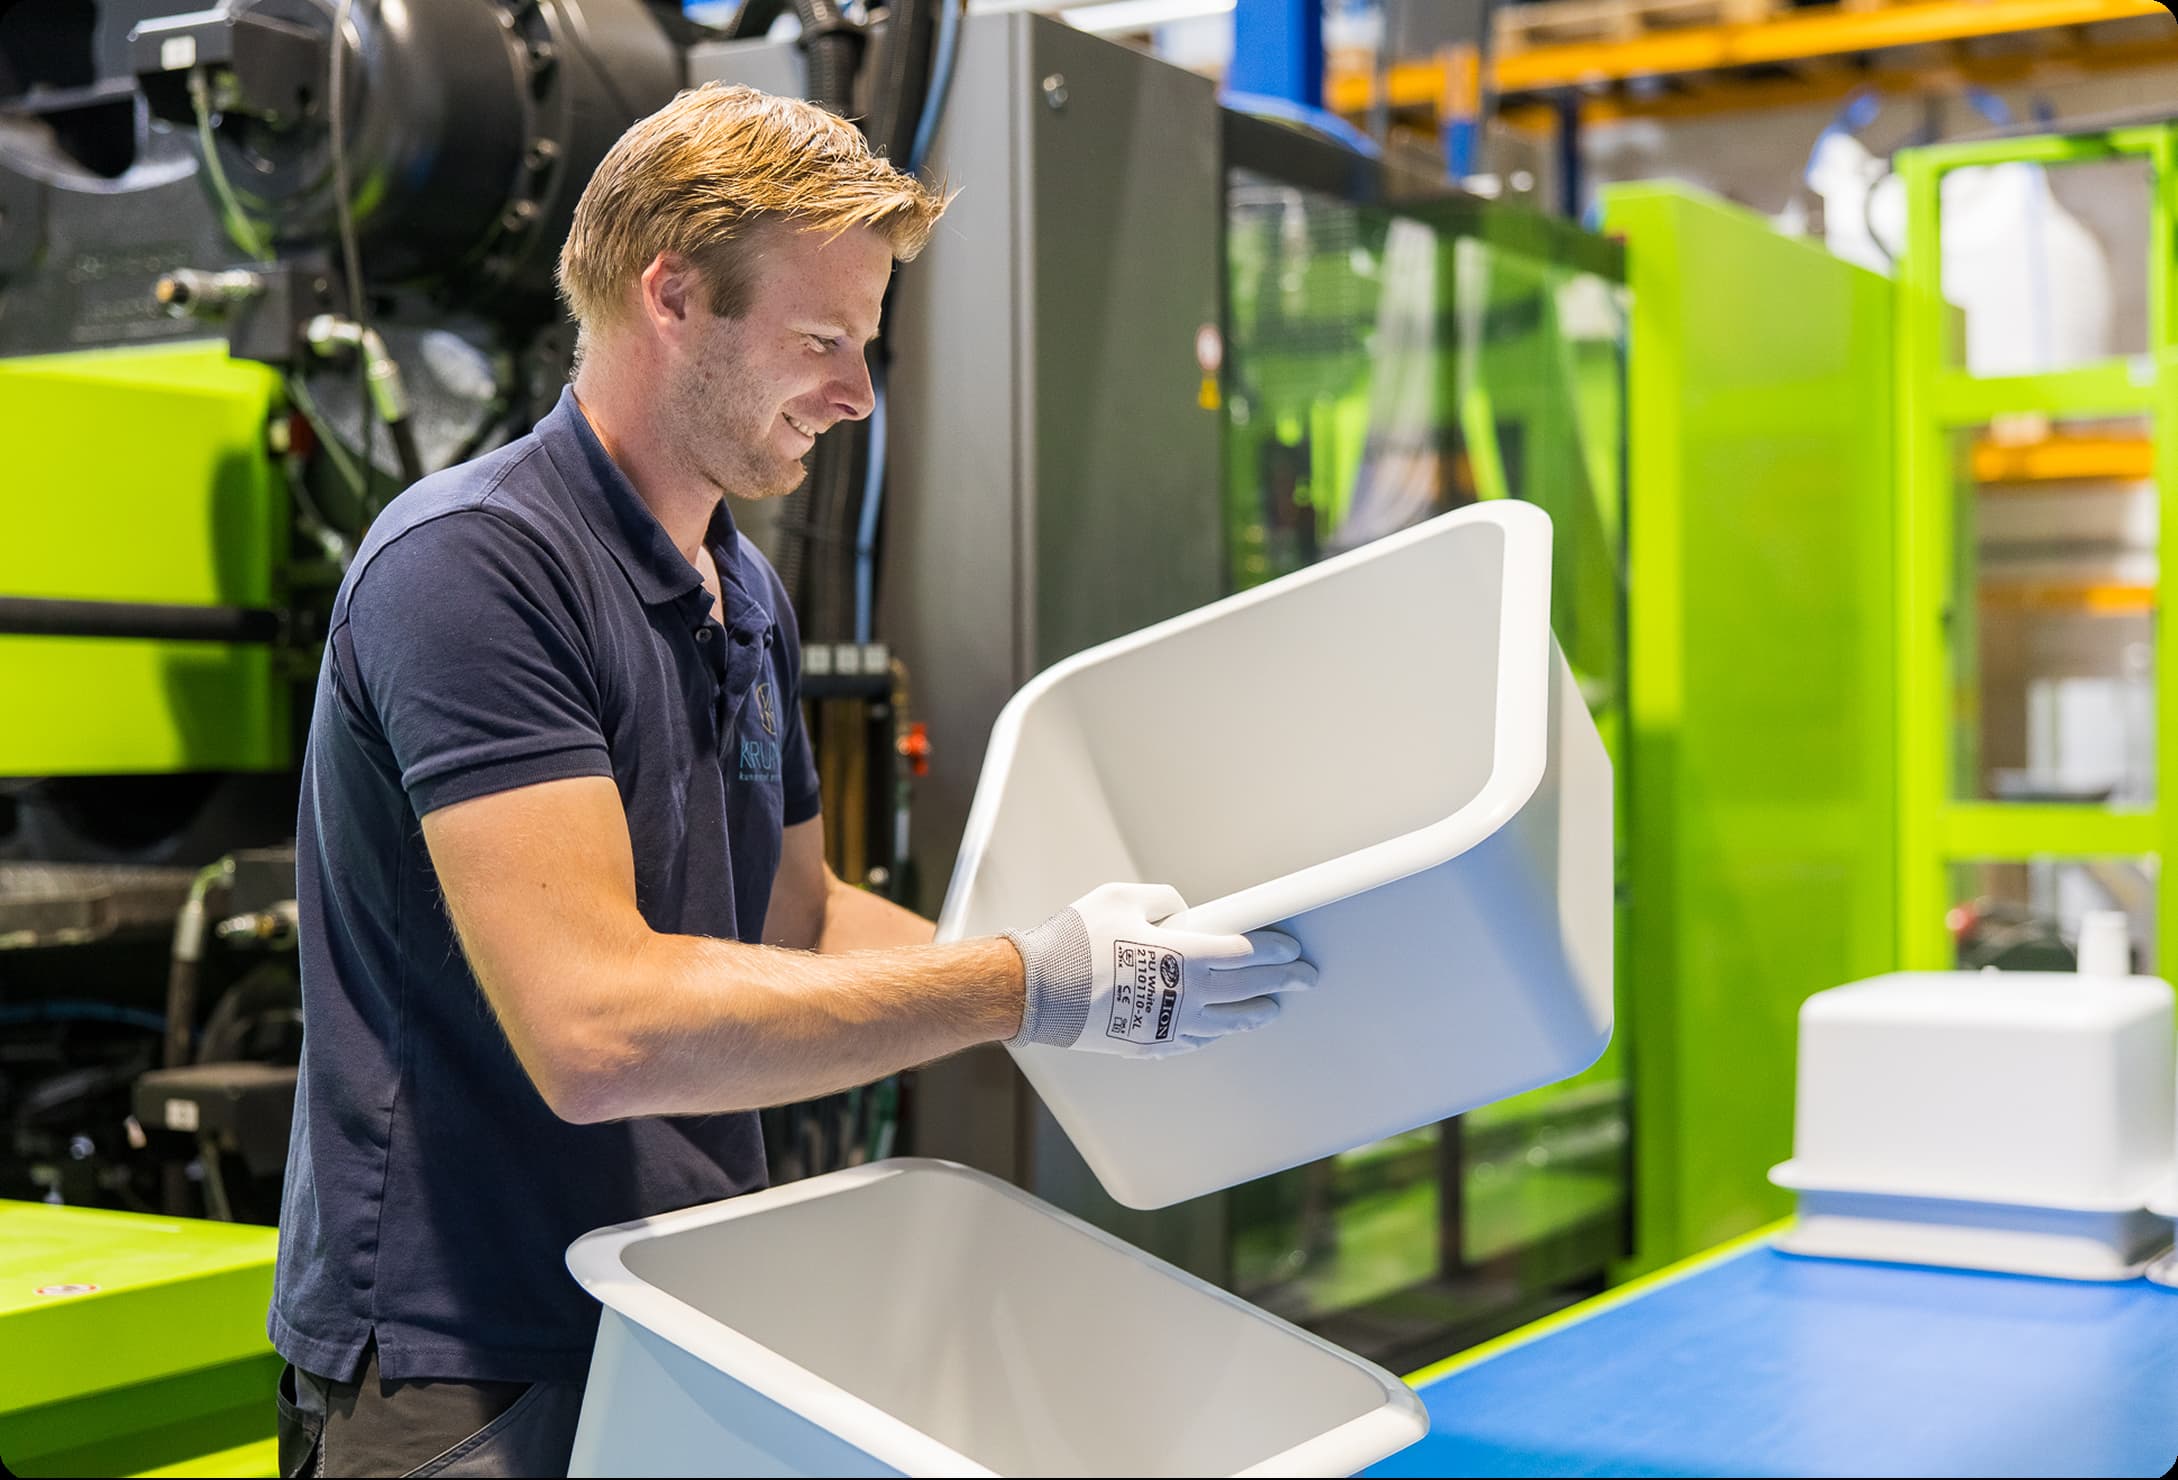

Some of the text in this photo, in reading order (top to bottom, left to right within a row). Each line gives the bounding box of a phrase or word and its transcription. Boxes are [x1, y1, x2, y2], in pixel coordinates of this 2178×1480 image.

[1122, 985, 1131, 1004] CE
[1132, 949, 1147, 1030] 2110110-XL
[1145, 950, 1156, 1013] PU White
[1157, 995, 1174, 1037] LION
